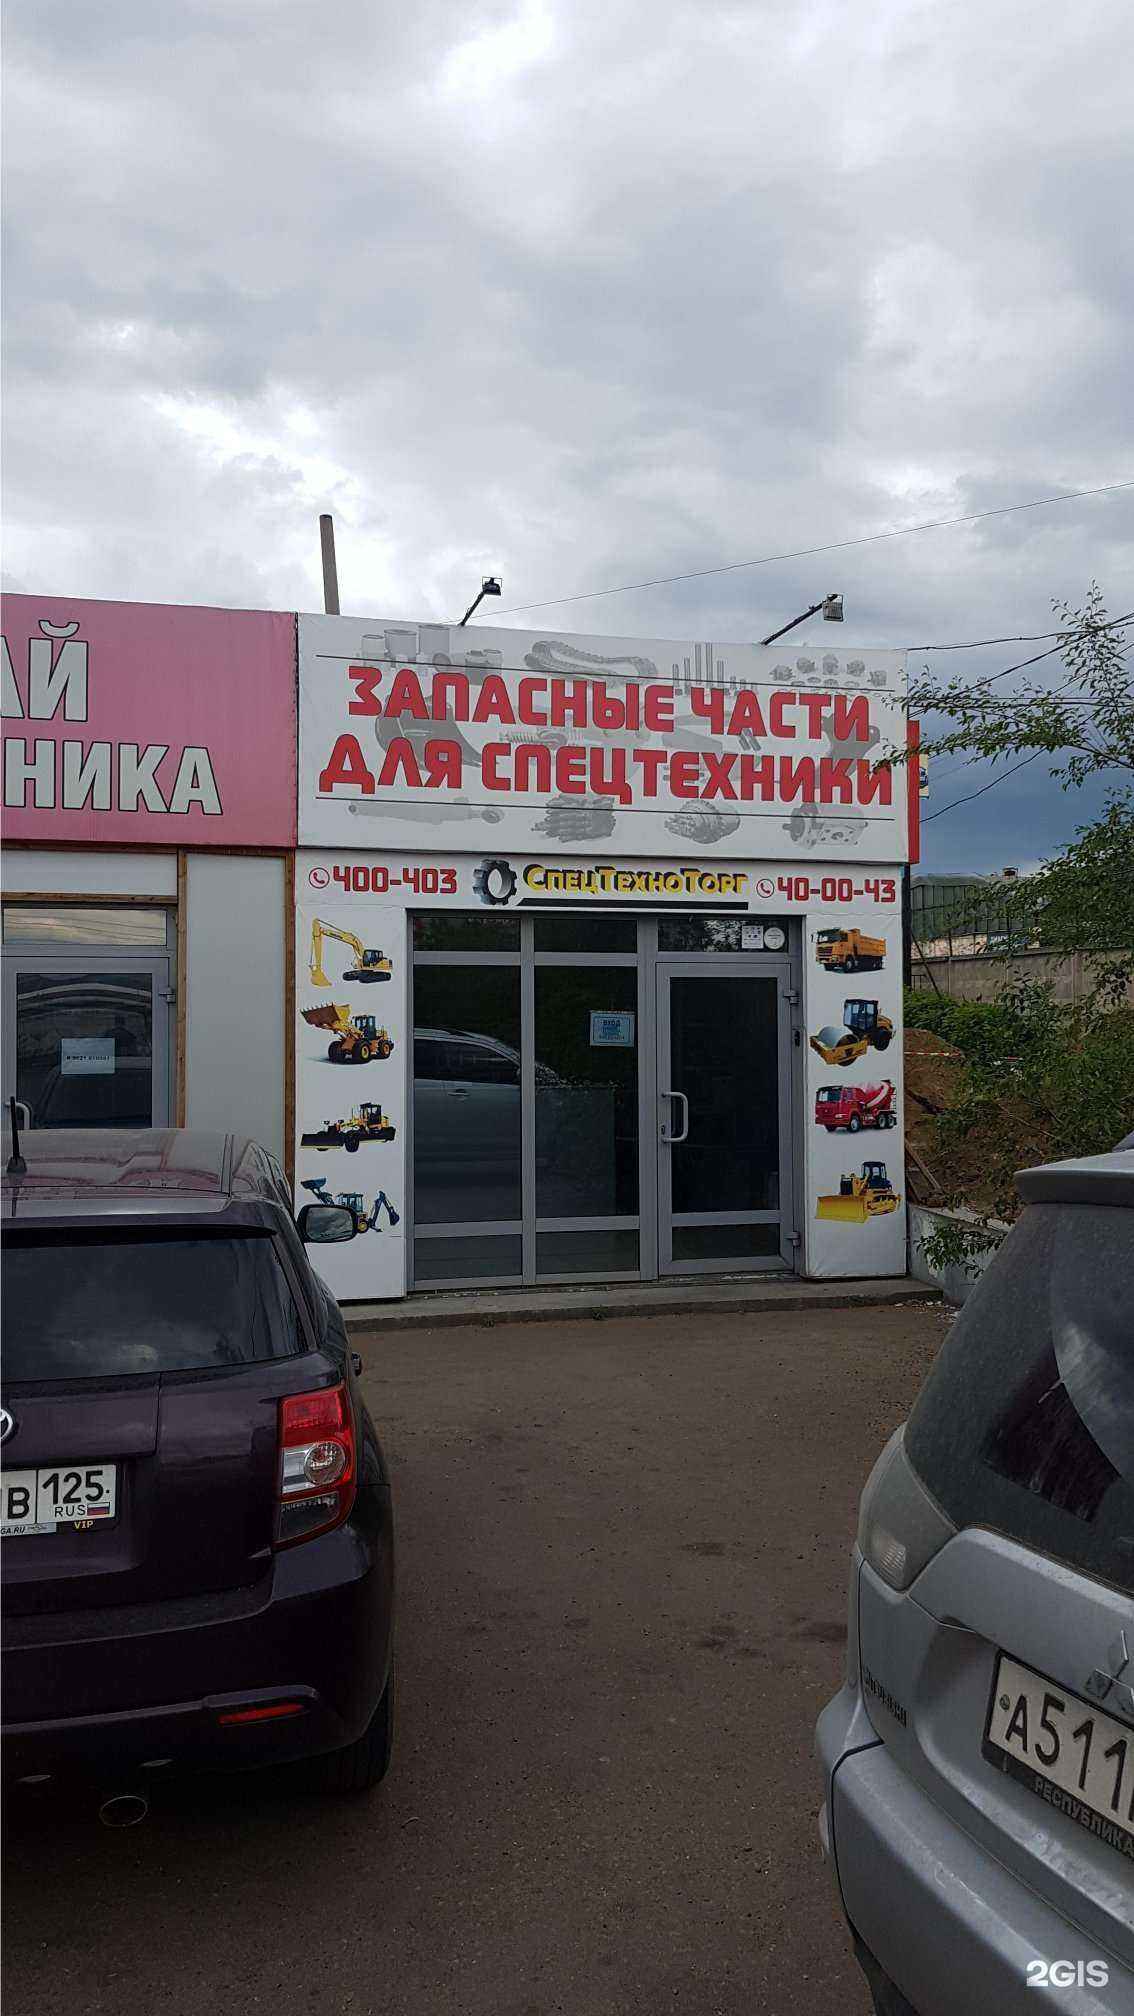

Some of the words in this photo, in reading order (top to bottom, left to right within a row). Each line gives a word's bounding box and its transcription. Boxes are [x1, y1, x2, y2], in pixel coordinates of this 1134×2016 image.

[348, 665, 674, 732] ЗАПАСНЫЕ
[691, 687, 869, 741] ЧАСТИ
[318, 733, 463, 794] ДЛЯ
[481, 742, 892, 806] СПЕЦТЕХНИКИ
[332, 866, 458, 894] 400-403
[777, 877, 896, 903] 40-00-43
[42, 1470, 104, 1505] 125
[54, 1504, 86, 1518] RUS
[74, 1521, 94, 1530] VIP
